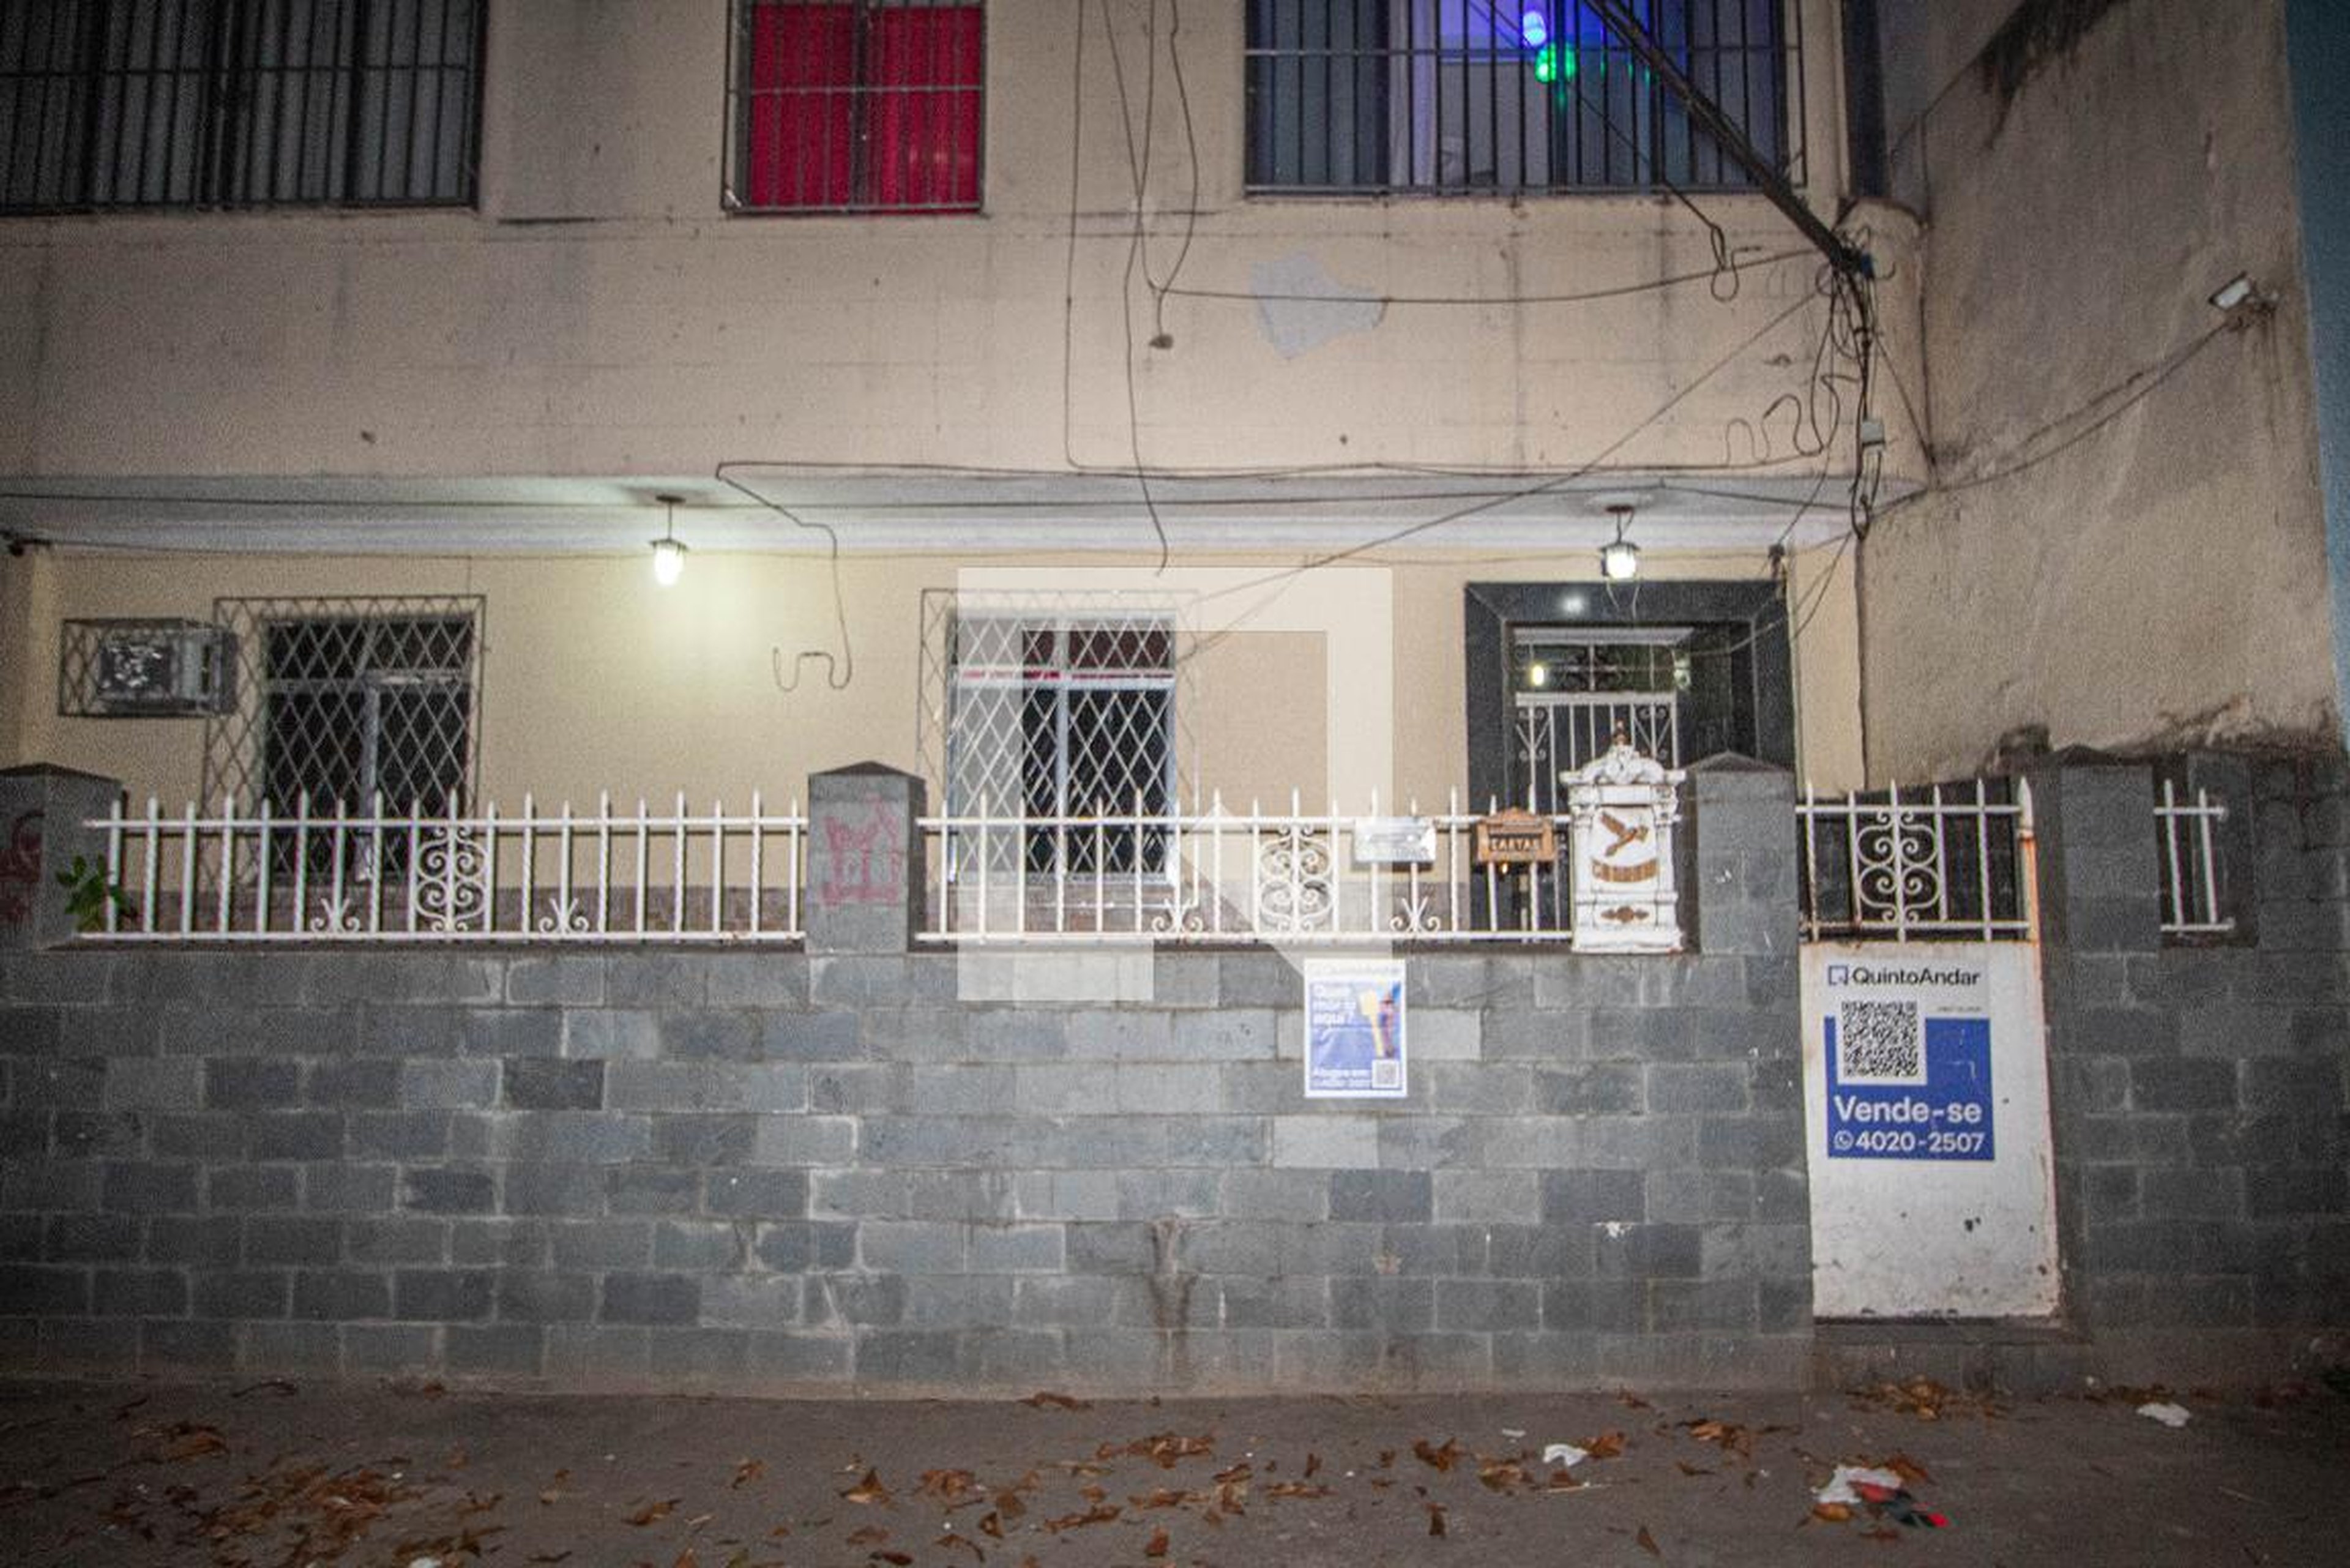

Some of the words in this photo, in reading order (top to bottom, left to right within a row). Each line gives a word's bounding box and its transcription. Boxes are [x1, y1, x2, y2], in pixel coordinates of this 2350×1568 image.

[1852, 965, 1980, 986] QuintoAndar
[1834, 1095, 1983, 1123] Vende-se
[1855, 1131, 1985, 1152] 4020-2507
